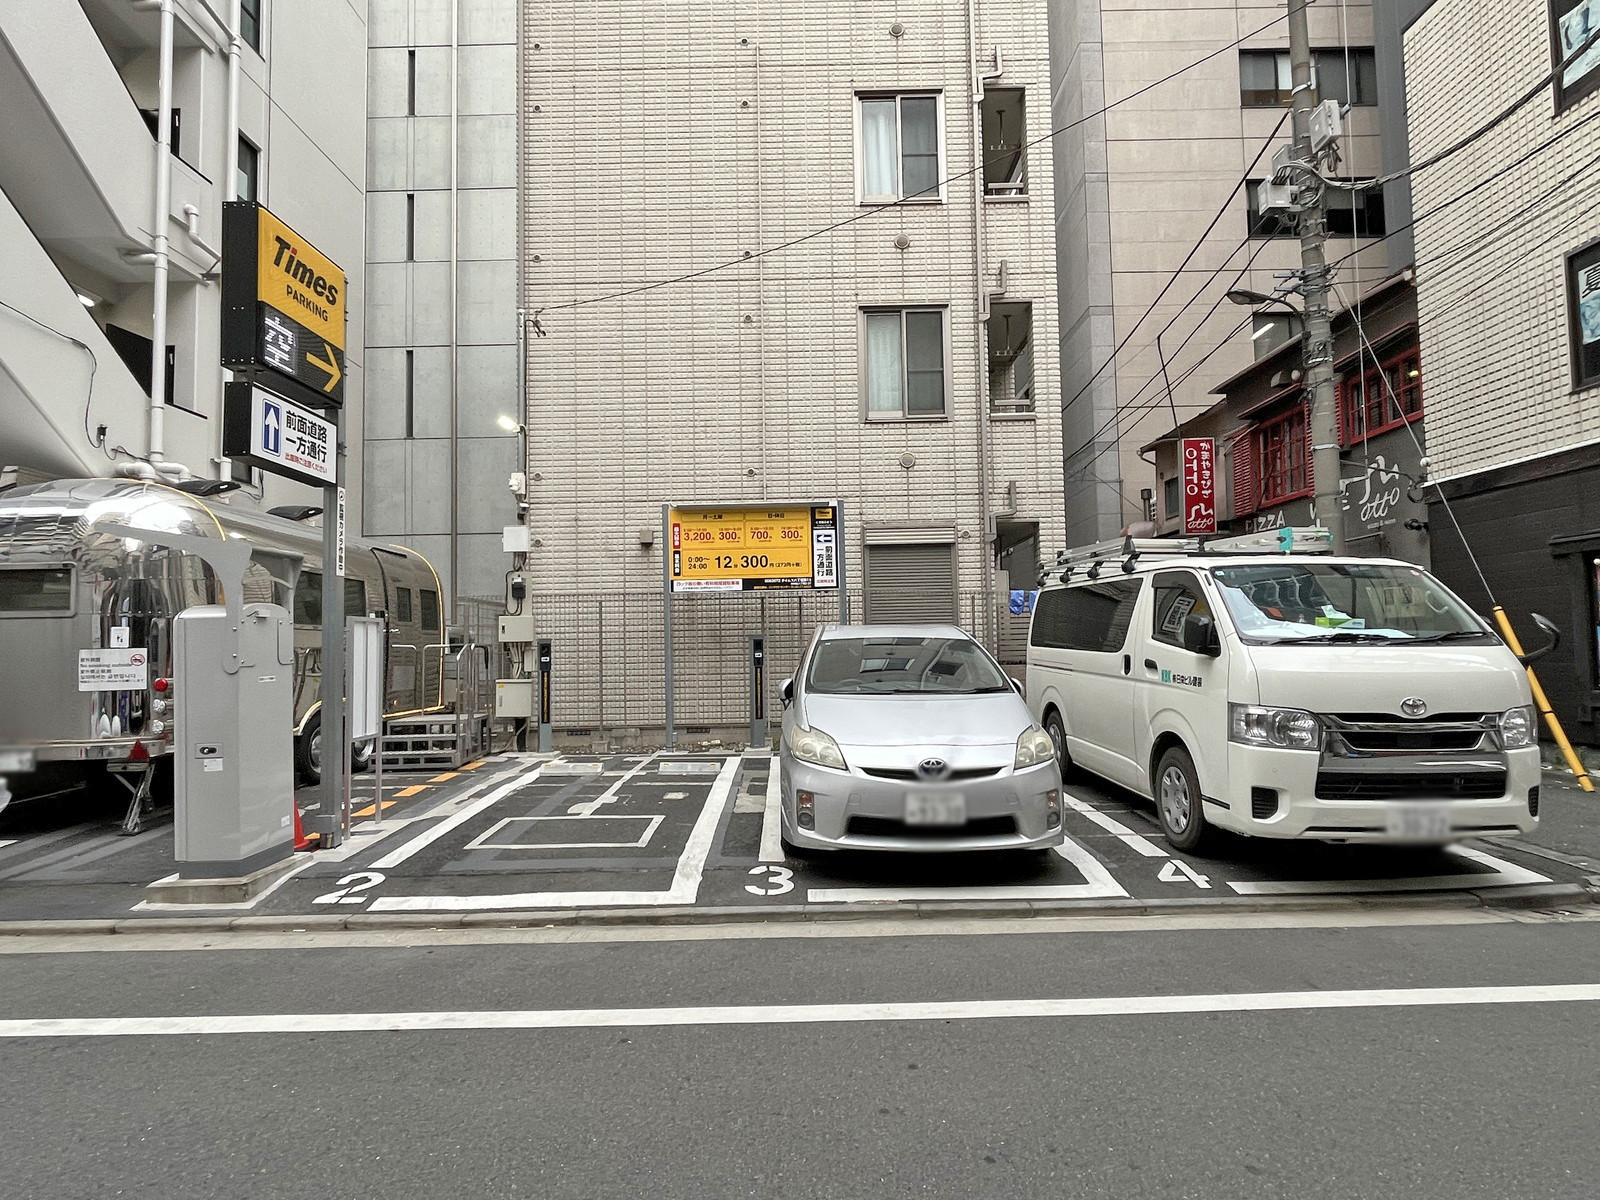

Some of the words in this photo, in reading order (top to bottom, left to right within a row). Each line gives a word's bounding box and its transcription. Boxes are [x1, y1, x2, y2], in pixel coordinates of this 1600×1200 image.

[274, 235, 339, 306] Times
[286, 284, 328, 322] PARKING
[264, 317, 296, 373] 空
[286, 410, 328, 444] 前面道路
[286, 436, 328, 463] 一方通行
[1186, 447, 1198, 495] OTTO
[1245, 510, 1286, 533] PIZZA
[312, 871, 386, 905] 2
[744, 865, 795, 897] 3
[1157, 859, 1213, 889] 4
